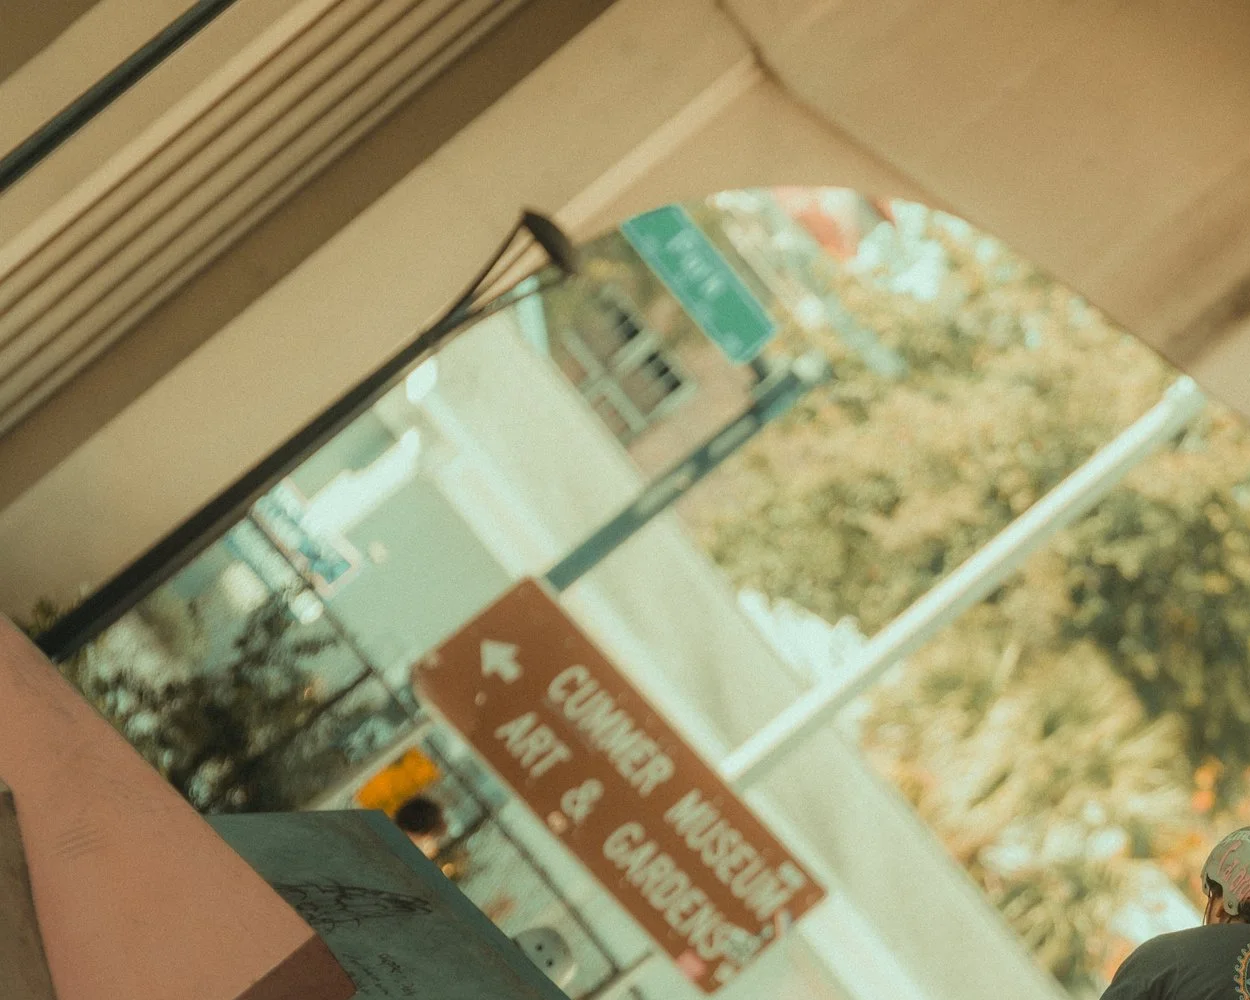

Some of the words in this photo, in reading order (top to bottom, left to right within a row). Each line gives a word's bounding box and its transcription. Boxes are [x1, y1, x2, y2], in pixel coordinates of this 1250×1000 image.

[494, 711, 573, 779] ART
[560, 777, 605, 825] &
[602, 821, 737, 961] GARDENS
[548, 664, 676, 798] CUMMER
[663, 788, 801, 921] MUSEUM
